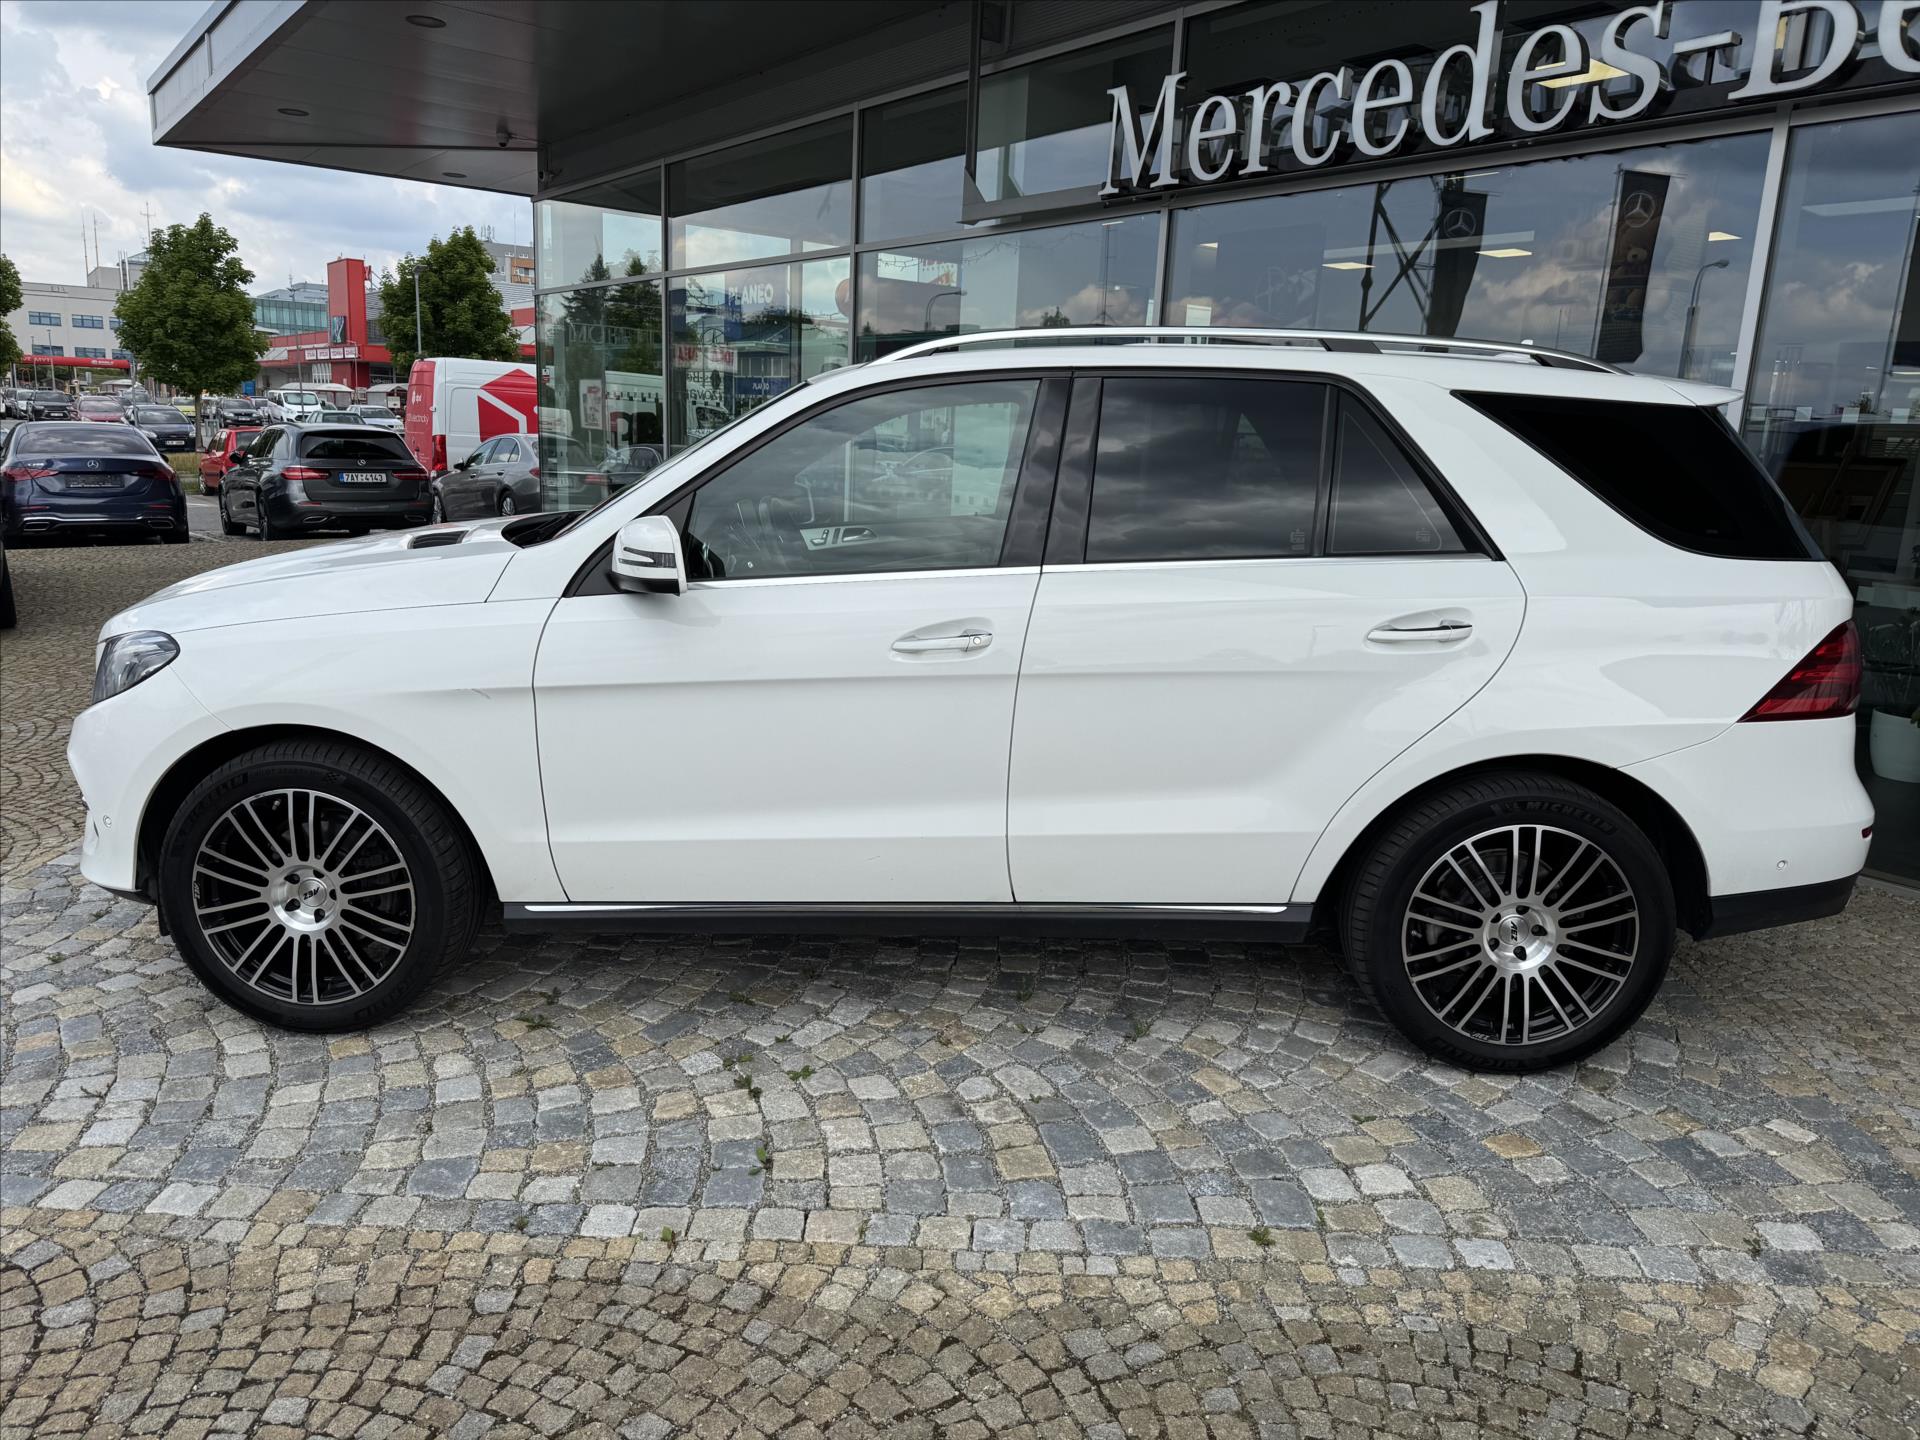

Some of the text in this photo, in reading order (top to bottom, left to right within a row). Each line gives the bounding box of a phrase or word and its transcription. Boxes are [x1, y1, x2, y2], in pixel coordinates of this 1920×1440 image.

[728, 283, 774, 306] PLANEO
[303, 886, 320, 901] AEZ
[1510, 919, 1518, 942] AEZ
